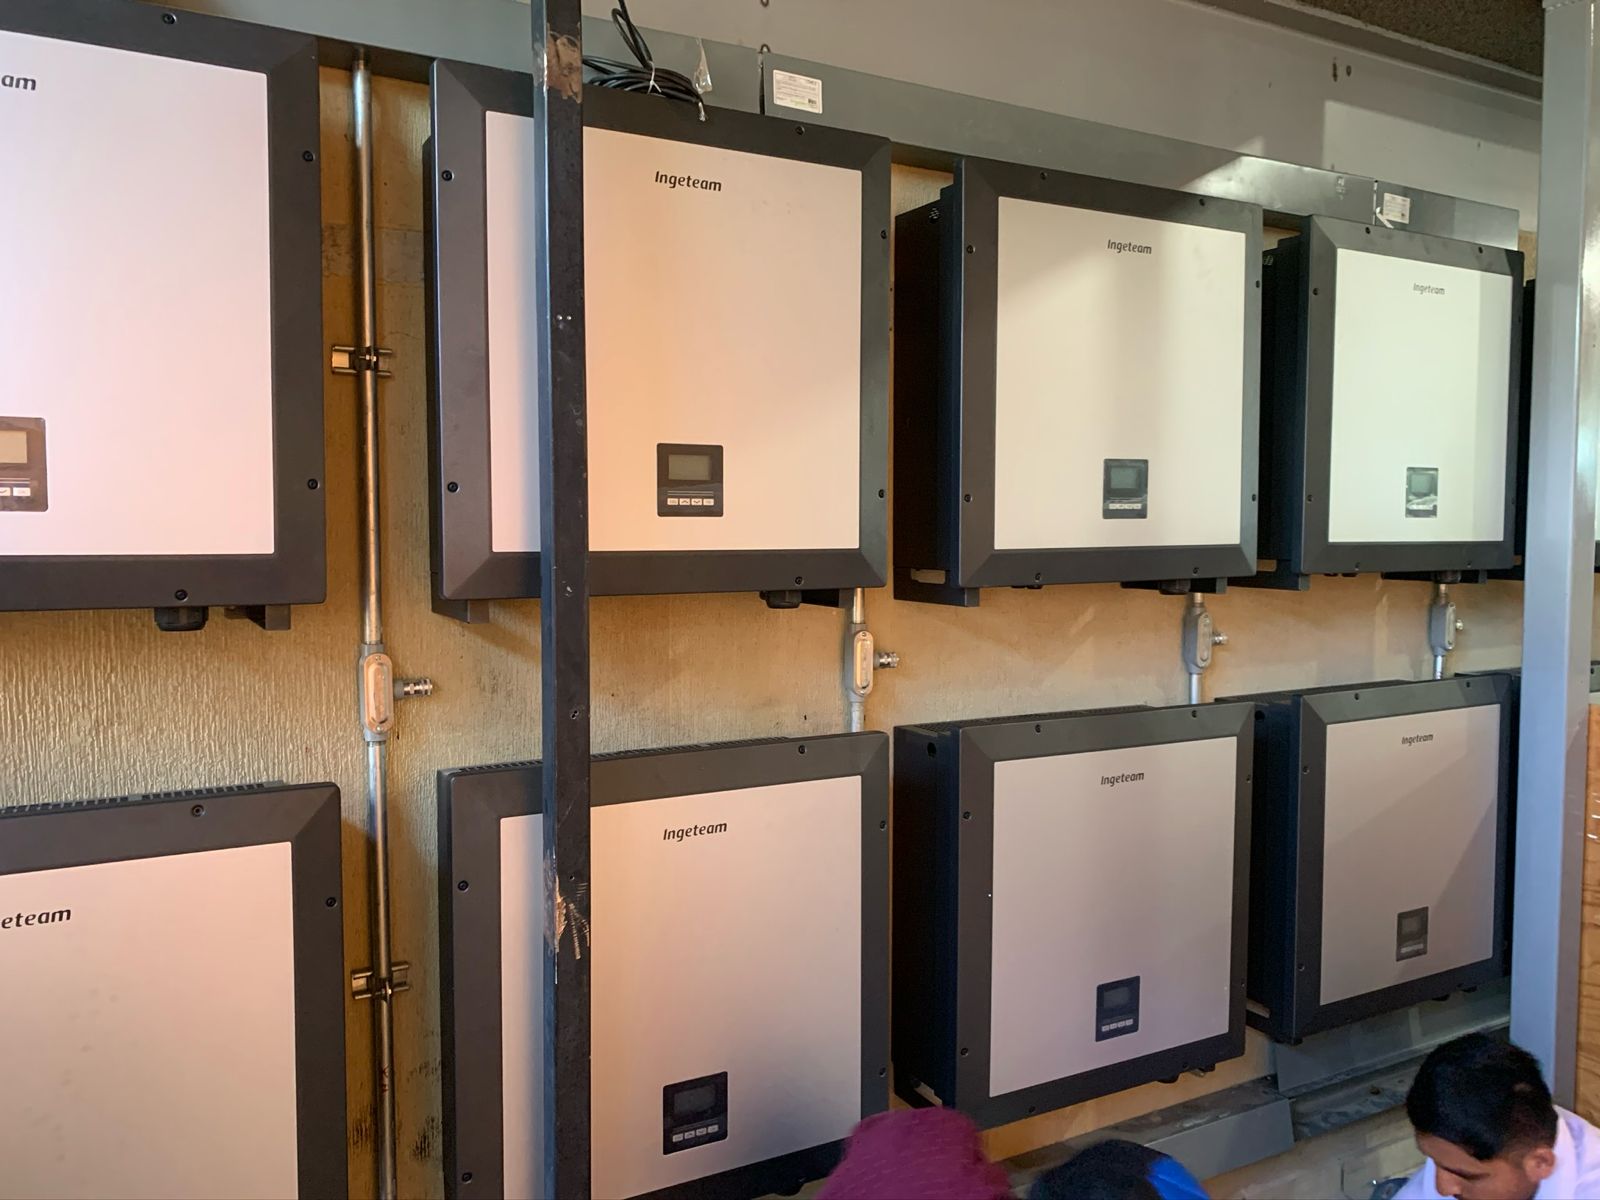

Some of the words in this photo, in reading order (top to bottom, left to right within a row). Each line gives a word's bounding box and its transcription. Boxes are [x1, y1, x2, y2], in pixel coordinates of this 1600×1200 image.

[655, 171, 722, 192] Ingeteam
[1107, 240, 1152, 255] Ingeteam
[1402, 734, 1433, 746] Ingeteam
[1101, 773, 1144, 787] Ingeteam
[663, 823, 727, 842] Ingeteam
